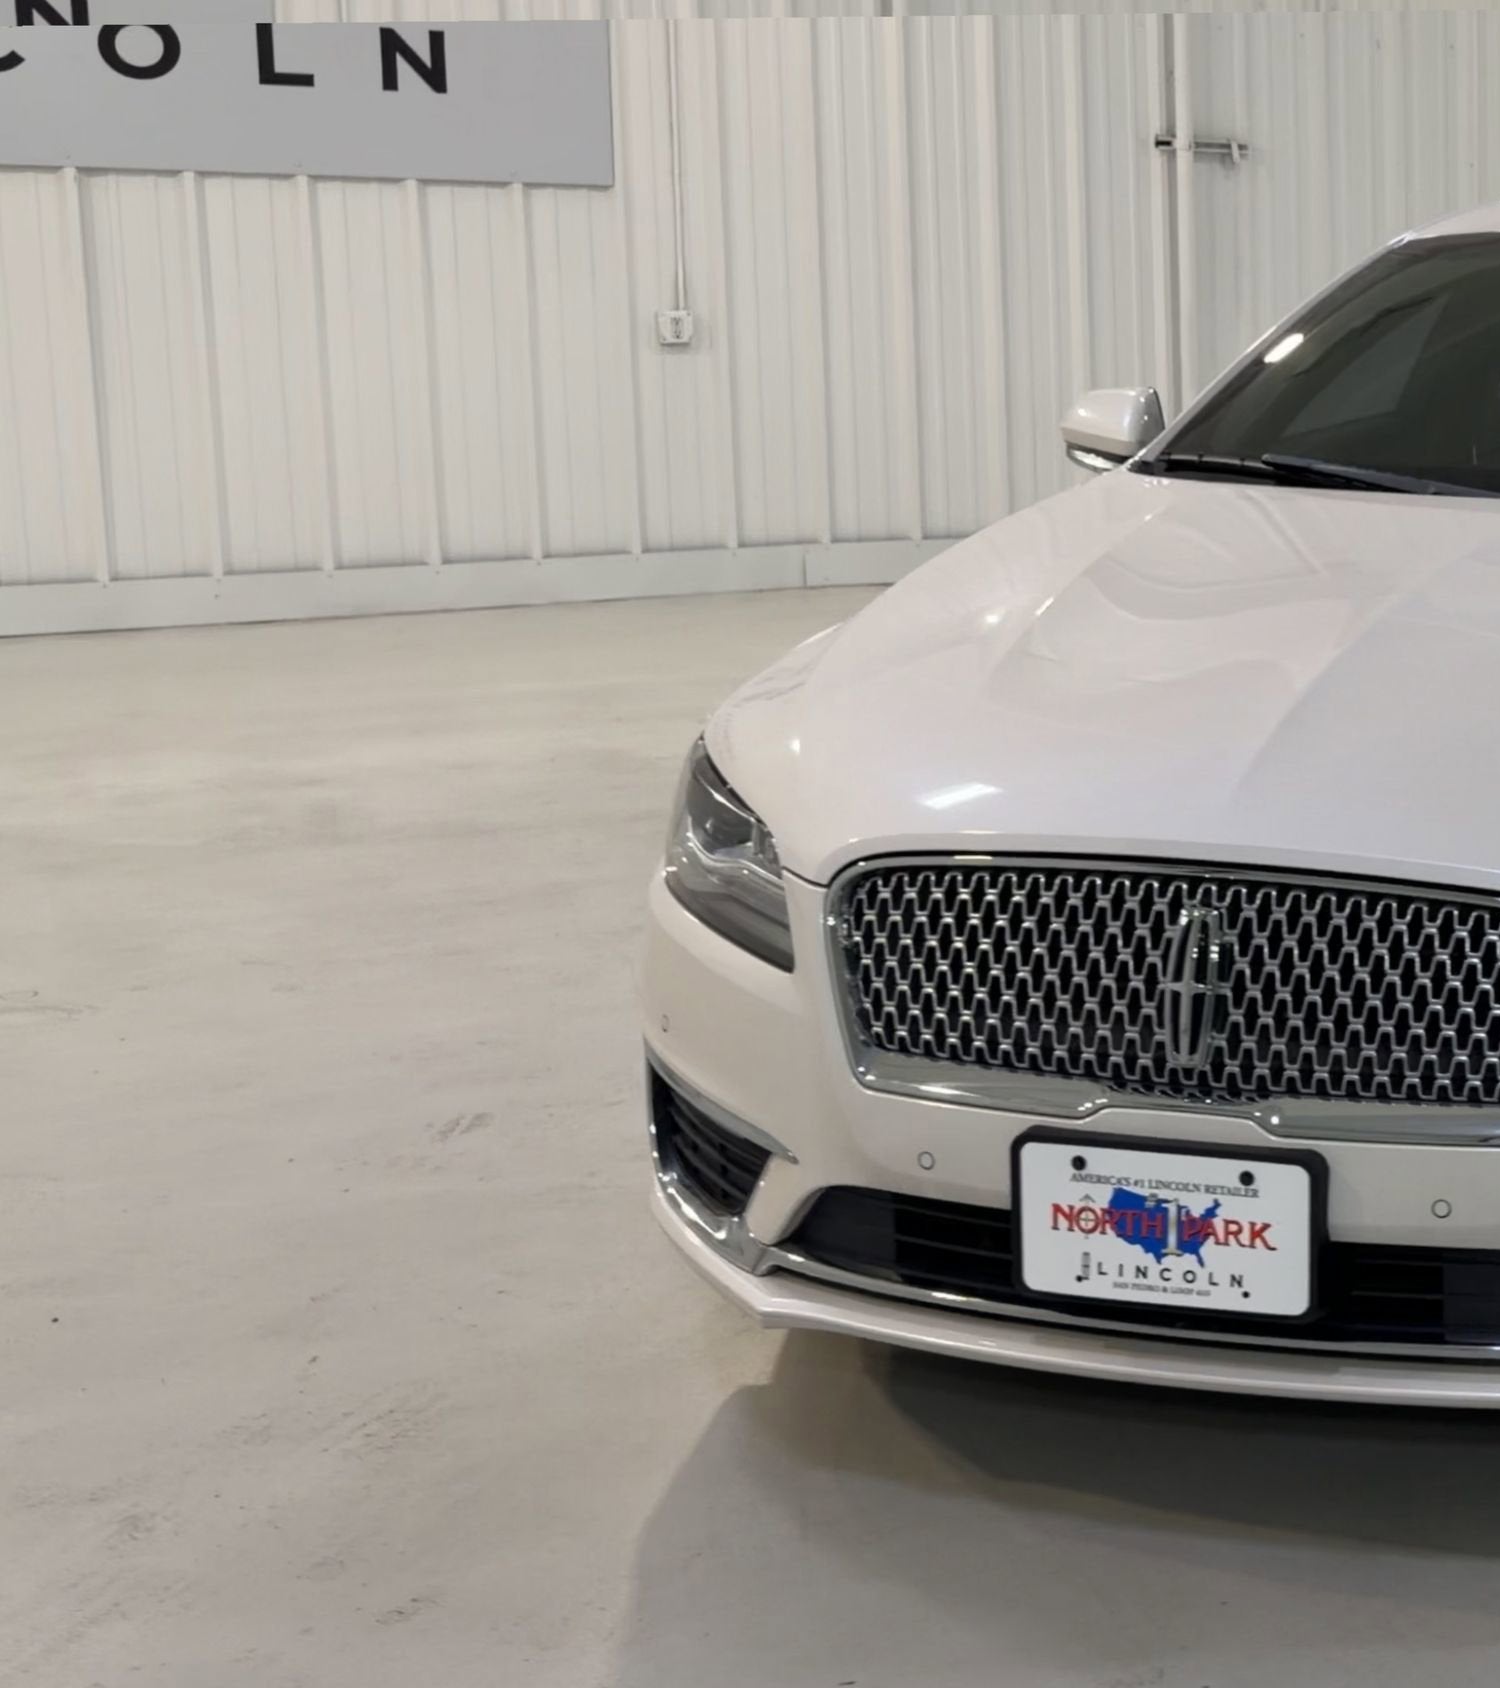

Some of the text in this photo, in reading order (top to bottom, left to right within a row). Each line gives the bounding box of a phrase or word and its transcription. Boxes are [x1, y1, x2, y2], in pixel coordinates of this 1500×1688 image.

[0, 23, 449, 95] OLN
[1148, 1179, 1202, 1193] LINCOLN
[1204, 1184, 1260, 1198] RETAILER
[1051, 1203, 1164, 1238] NORTH
[1184, 1213, 1278, 1251] PARK
[1097, 1261, 1244, 1288] LINCOLN
